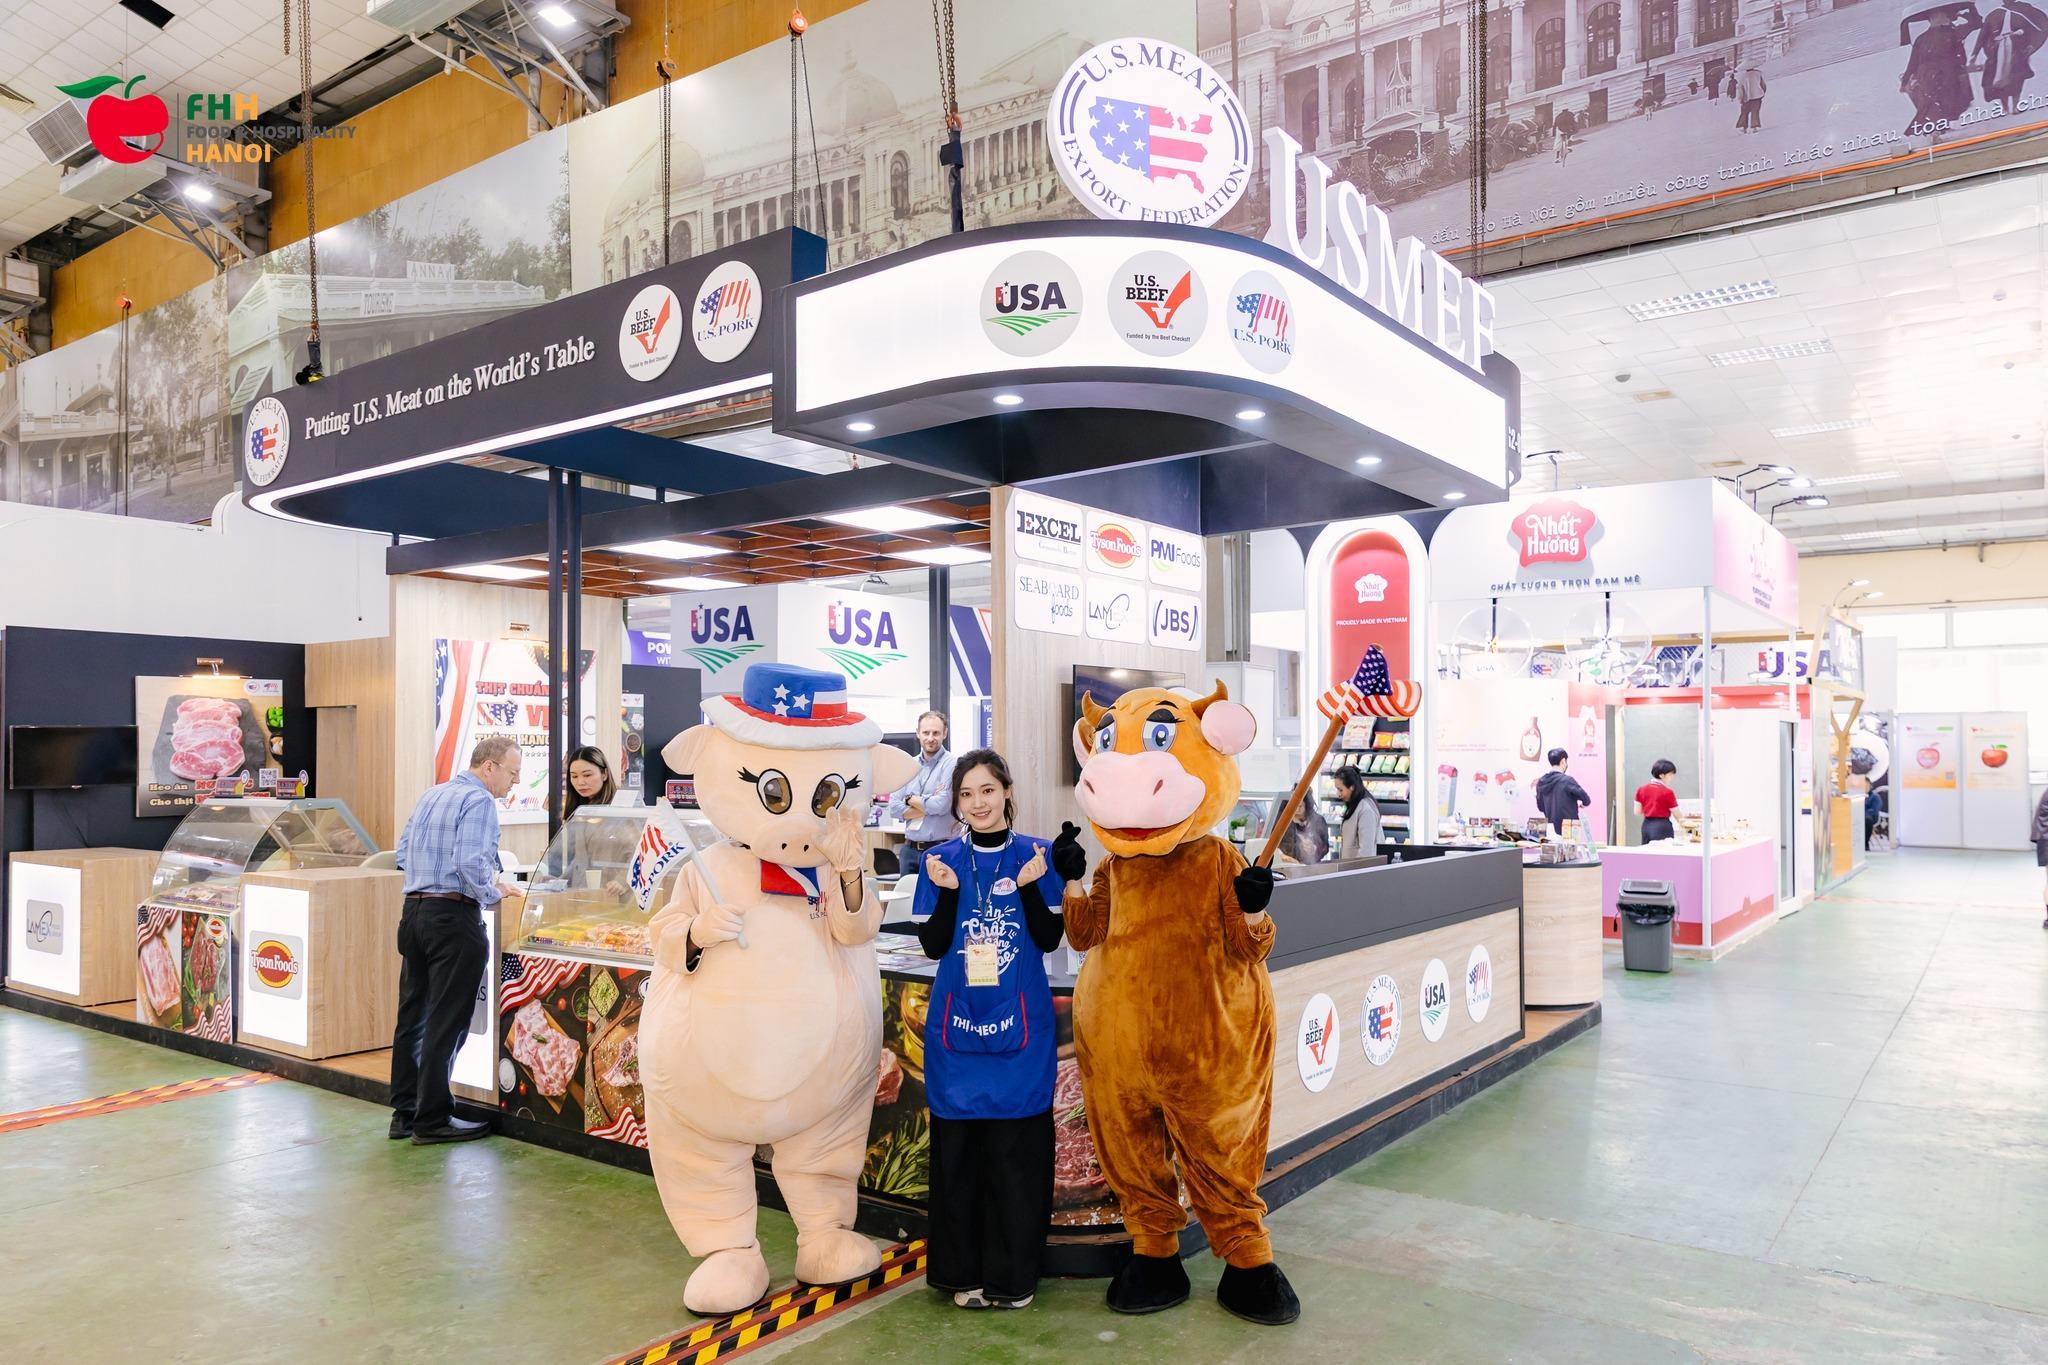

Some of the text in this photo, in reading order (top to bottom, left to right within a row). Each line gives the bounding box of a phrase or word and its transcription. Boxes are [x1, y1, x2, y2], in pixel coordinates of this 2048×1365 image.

[1529, 205, 1558, 224] Nội
[1564, 194, 1597, 219] gồm
[1603, 181, 1658, 207] nhiều
[1664, 170, 1710, 193] công
[1717, 156, 1776, 181] trình
[1783, 143, 1834, 168] khác
[1911, 115, 1951, 137] tòa
[1960, 101, 2008, 127] nhà
[1063, 138, 1246, 226] EXPORT FEDERATION
[1264, 127, 1497, 376] USMEF
[1133, 274, 1160, 287] U.S.
[995, 280, 1067, 314] USA
[1125, 286, 1169, 302] BEEF
[630, 317, 656, 336] BEEF
[635, 308, 651, 321] U.S.
[697, 316, 754, 342] U.S. PORK
[1126, 332, 1144, 340] Funded
[1232, 328, 1292, 355] U.S. PORK
[305, 408, 352, 440] Putting
[352, 397, 383, 426] U.S.
[386, 389, 422, 417] Meat
[424, 383, 445, 406] on
[448, 372, 472, 400] the
[543, 335, 596, 373] Table
[1016, 509, 1081, 543] EXCEL
[1525, 511, 1582, 538] Nhất
[1150, 538, 1201, 568] PMI Foods
[1527, 535, 1580, 557] Hương
[1624, 573, 1641, 583] MÊ
[690, 604, 755, 645] USA
[828, 603, 898, 650] USA
[1335, 618, 1360, 626] PROUDLY
[1382, 616, 1408, 624] VIETNAM
[475, 681, 507, 697] THỊT
[148, 783, 172, 791] Heo
[149, 797, 173, 806] Cho
[647, 841, 687, 885] PORK
[1424, 982, 1446, 1009] USA
[1305, 1028, 1323, 1046] BEEF
[1308, 1018, 1320, 1031] U.S.
